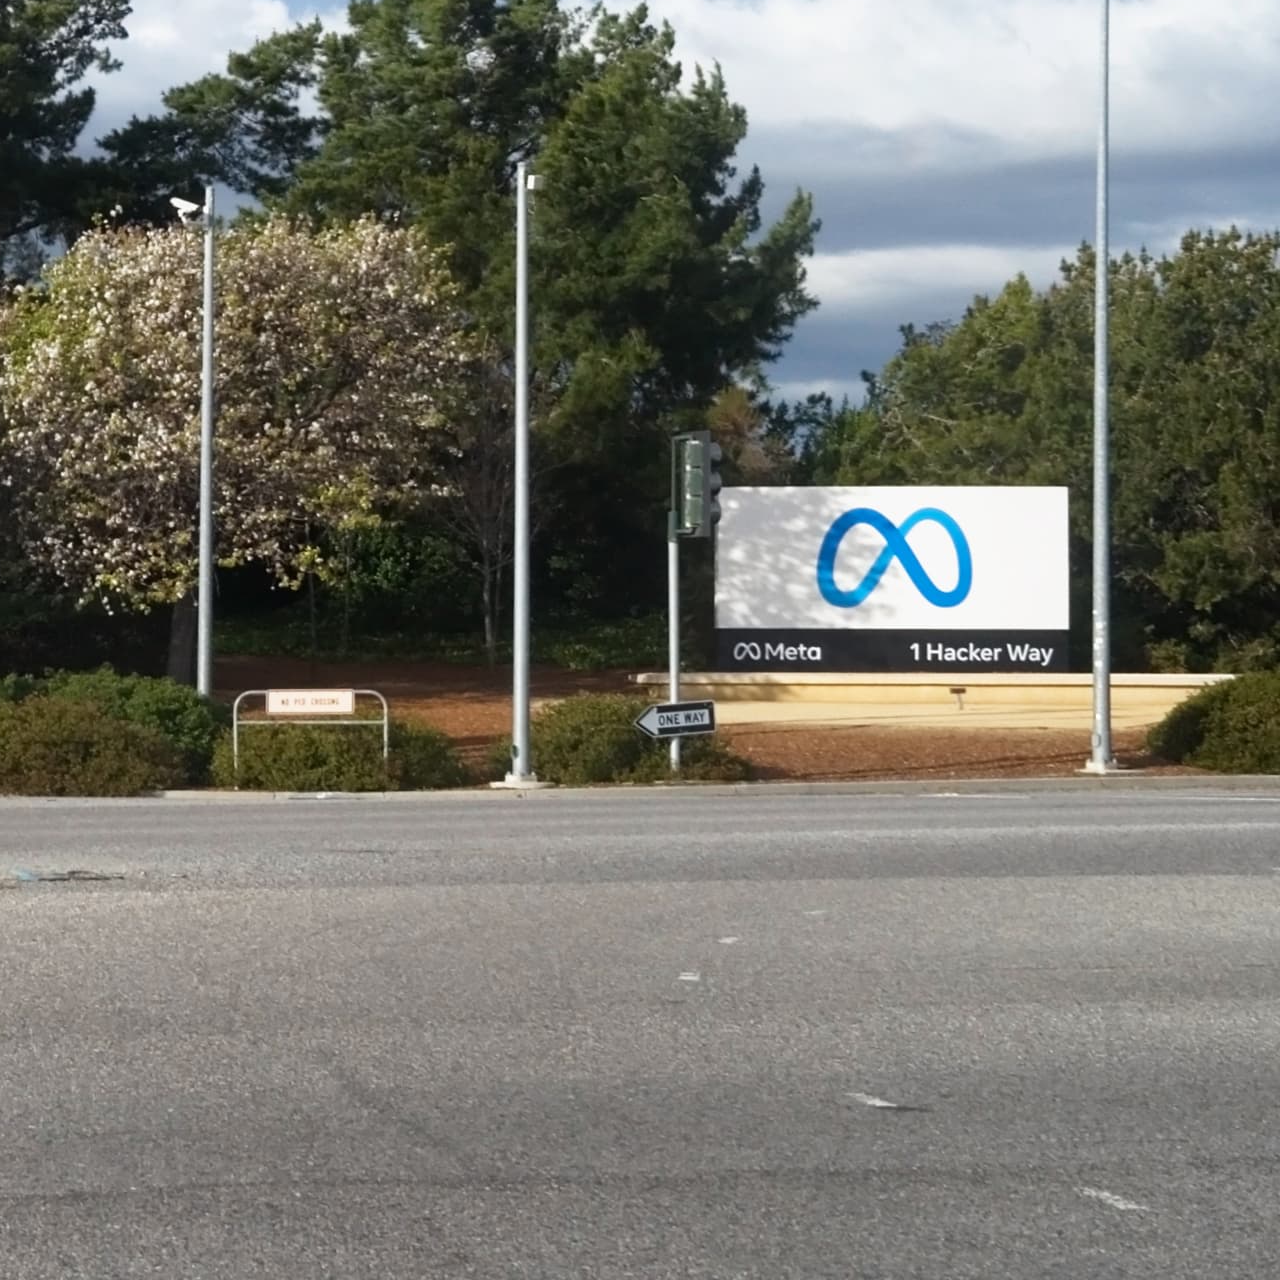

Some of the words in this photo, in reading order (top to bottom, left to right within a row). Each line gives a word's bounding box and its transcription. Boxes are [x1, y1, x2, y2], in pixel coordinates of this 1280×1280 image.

[764, 643, 822, 662] Meta
[910, 643, 920, 661] 1
[926, 643, 1002, 662] Hacker
[1007, 644, 1054, 666] Way
[658, 713, 681, 726] ONE
[684, 711, 706, 724] WAY
